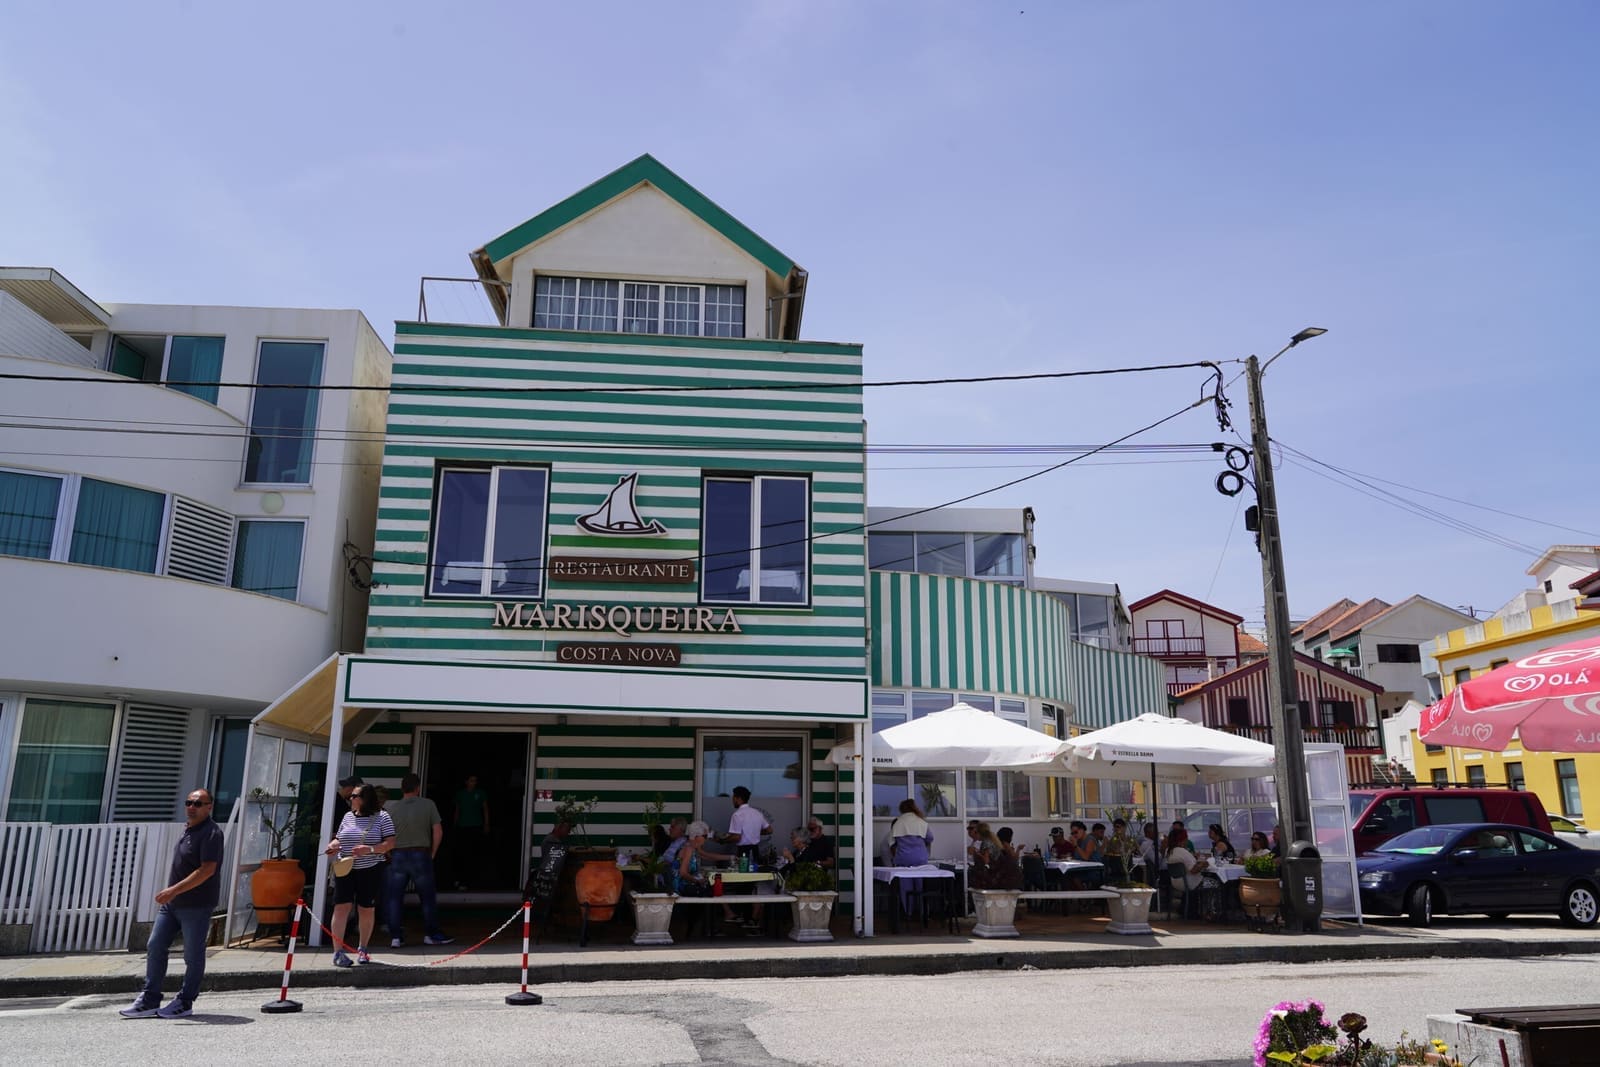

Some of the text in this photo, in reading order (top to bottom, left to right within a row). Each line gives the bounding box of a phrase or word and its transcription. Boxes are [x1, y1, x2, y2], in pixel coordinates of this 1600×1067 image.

[553, 560, 689, 578] RESTAURANTE
[492, 602, 742, 638] MARISQUEIRA
[559, 646, 677, 662] COSTA NOVA
[1548, 667, 1589, 686] OLÁ
